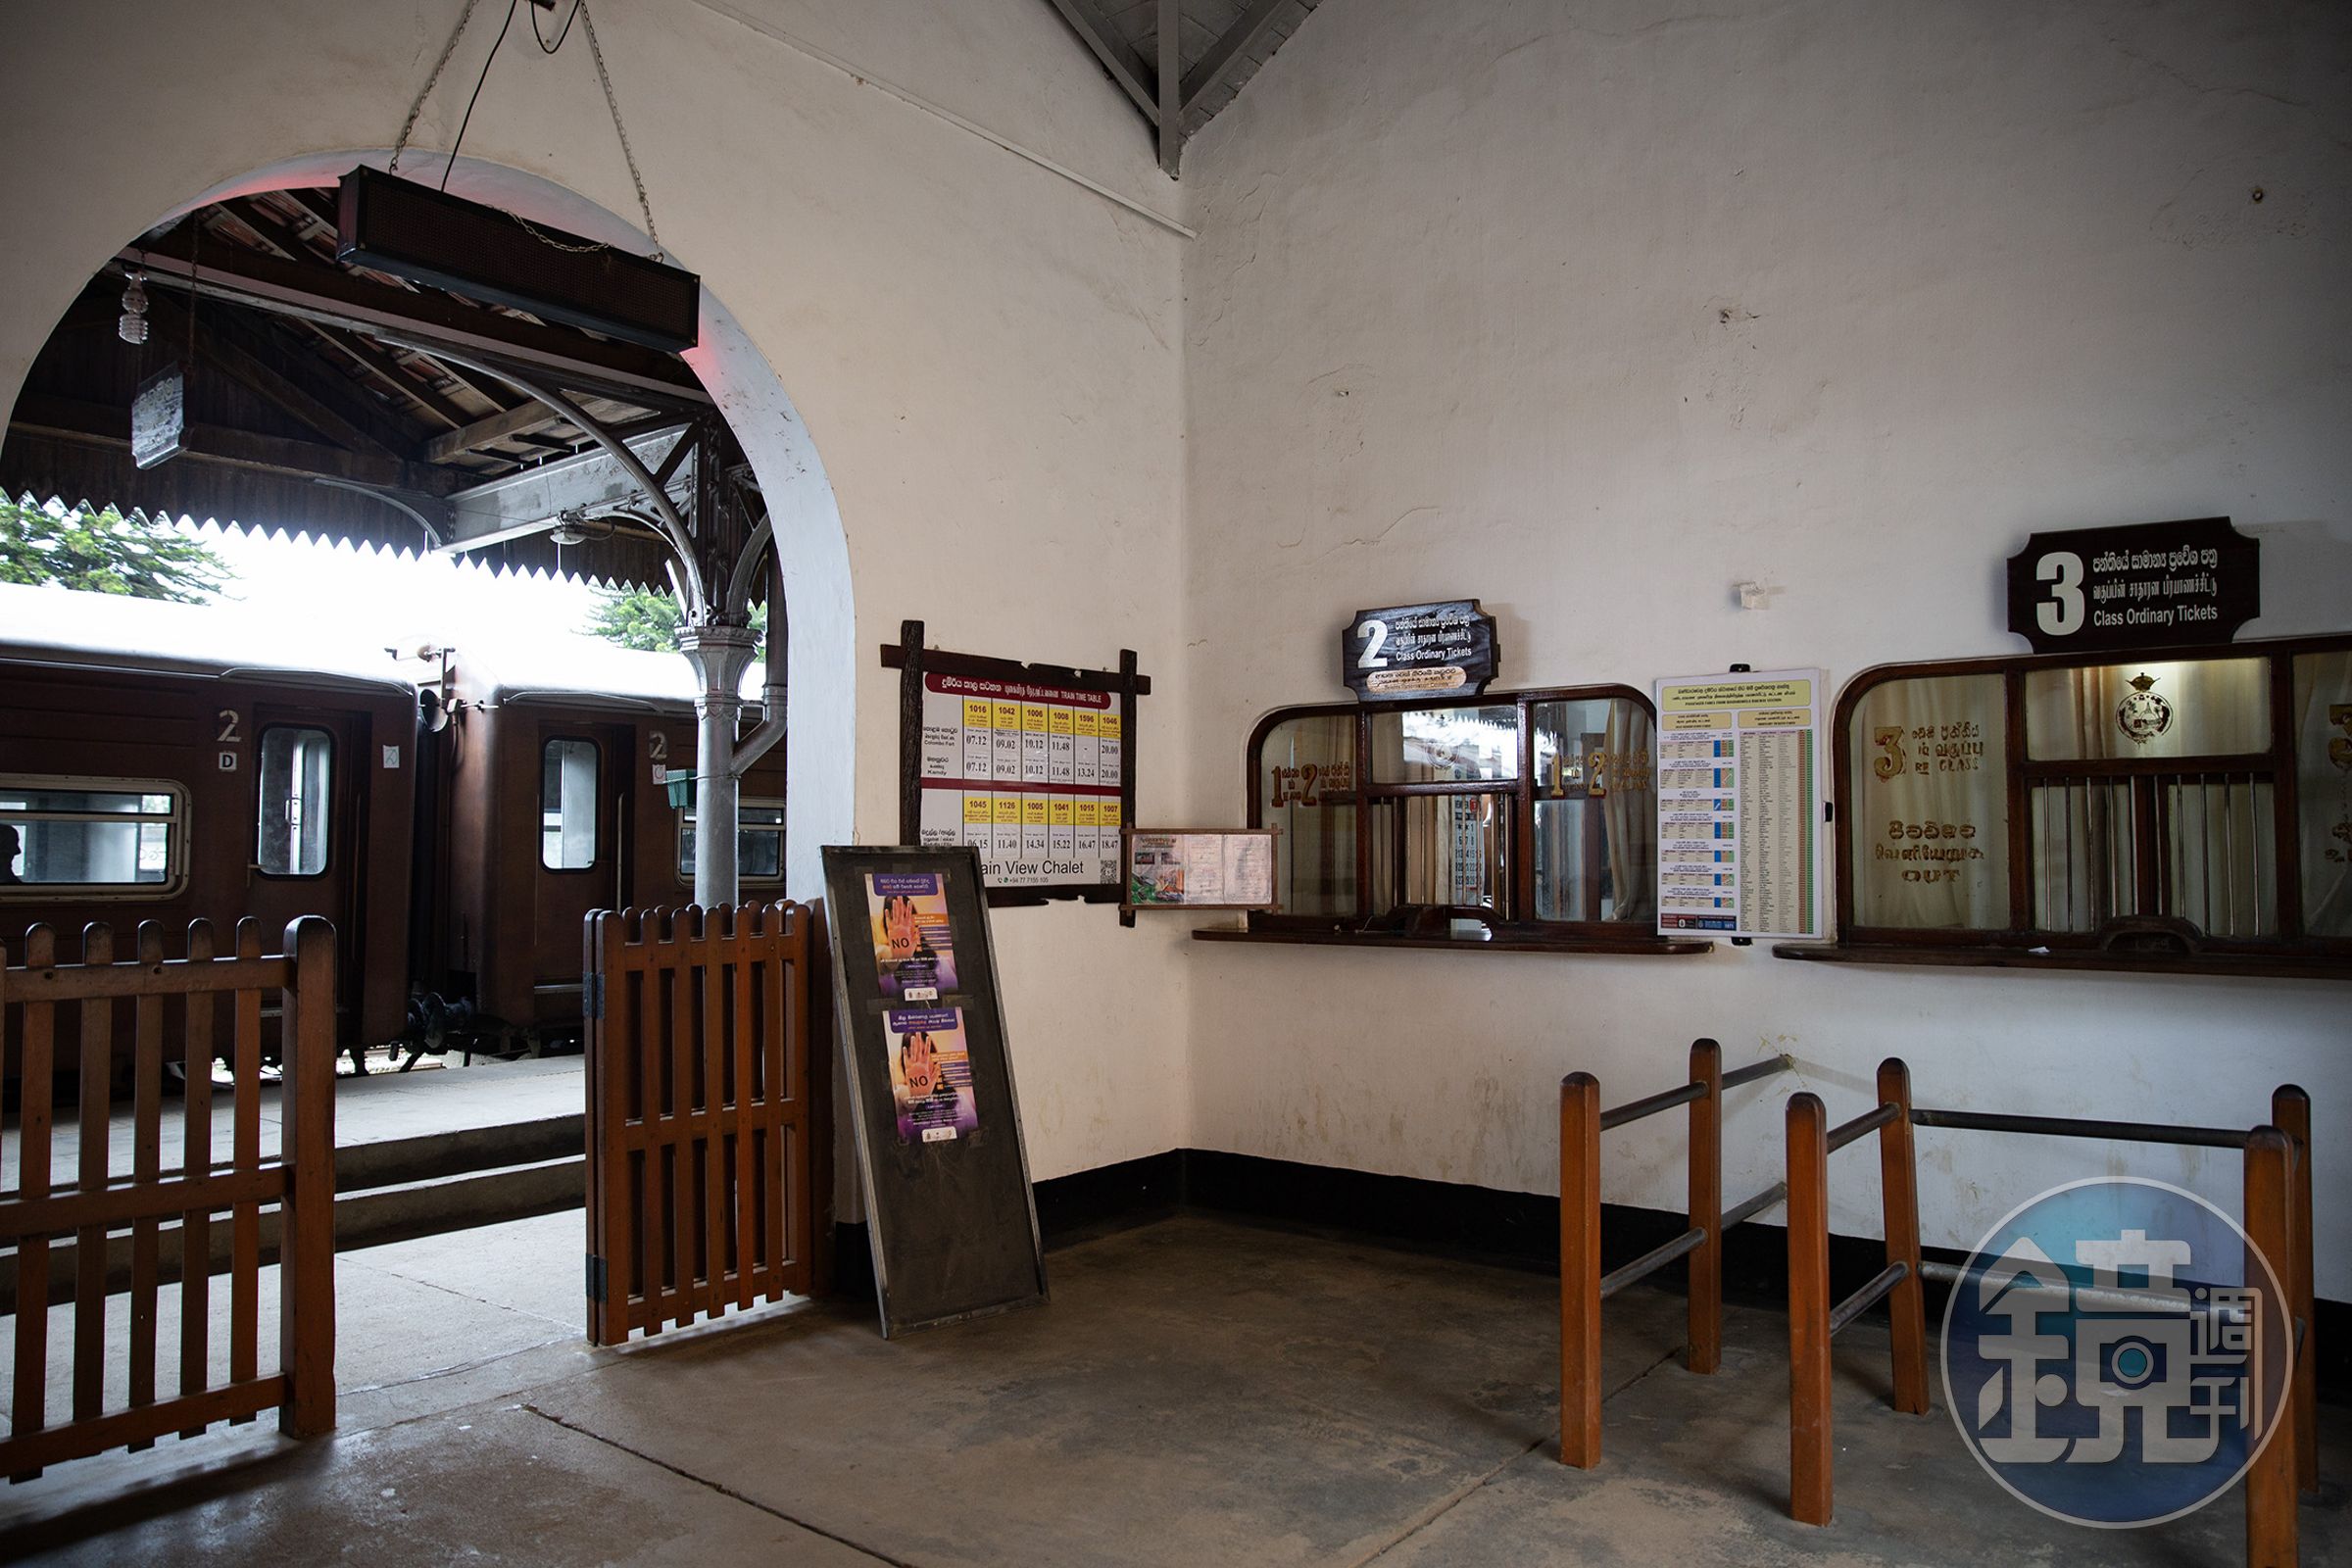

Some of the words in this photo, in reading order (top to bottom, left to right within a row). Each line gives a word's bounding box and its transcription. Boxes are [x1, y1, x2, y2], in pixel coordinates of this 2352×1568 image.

[2035, 551, 2085, 636] 3
[2093, 610, 2124, 627] Class
[2126, 607, 2175, 626] Ordinary
[2177, 604, 2218, 622] Tickets
[1357, 619, 1388, 668] 2
[1396, 651, 1415, 662] Class
[1415, 649, 1446, 661] Ordinary
[1446, 647, 1472, 658] Tickets
[1060, 690, 1075, 700] TRAIN
[1076, 692, 1087, 702] TIME
[1087, 694, 1102, 704] TABLE
[969, 705, 987, 713] 1016
[999, 707, 1015, 715] 1042
[217, 710, 242, 743] 2
[649, 731, 667, 759] 2
[966, 737, 987, 746] 07.12
[996, 740, 1015, 750] 09.02
[1025, 740, 1043, 749] 10.12
[1052, 743, 1070, 752] 11.48
[1102, 745, 1118, 755] 20.00
[2328, 704, 2352, 771] 3
[221, 754, 233, 768] D
[1873, 726, 1905, 780] 3
[966, 762, 987, 772] 07.12
[996, 764, 1015, 774] 09.02
[1025, 764, 1043, 774] 10.12
[1052, 767, 1070, 776] 11.48
[1078, 768, 1095, 777] 13.24
[1102, 770, 1118, 779] 20.00
[1939, 758, 1980, 772] CLASS
[1551, 753, 1565, 800] 1
[1589, 752, 1607, 799] 2
[1271, 765, 1285, 808] 1
[1300, 763, 1318, 807] 2
[998, 839, 1017, 849] 11.40
[1026, 839, 1045, 849] 14.34
[1053, 839, 1070, 849] 15.22
[1078, 839, 1096, 849] 16.47
[1102, 839, 1118, 849] 18.47
[980, 860, 1001, 875] ain
[1004, 860, 1039, 875] View
[1042, 859, 1084, 874] Chalet
[1901, 869, 1960, 884] OUT
[892, 937, 909, 950] NO
[909, 1075, 928, 1089] NO
